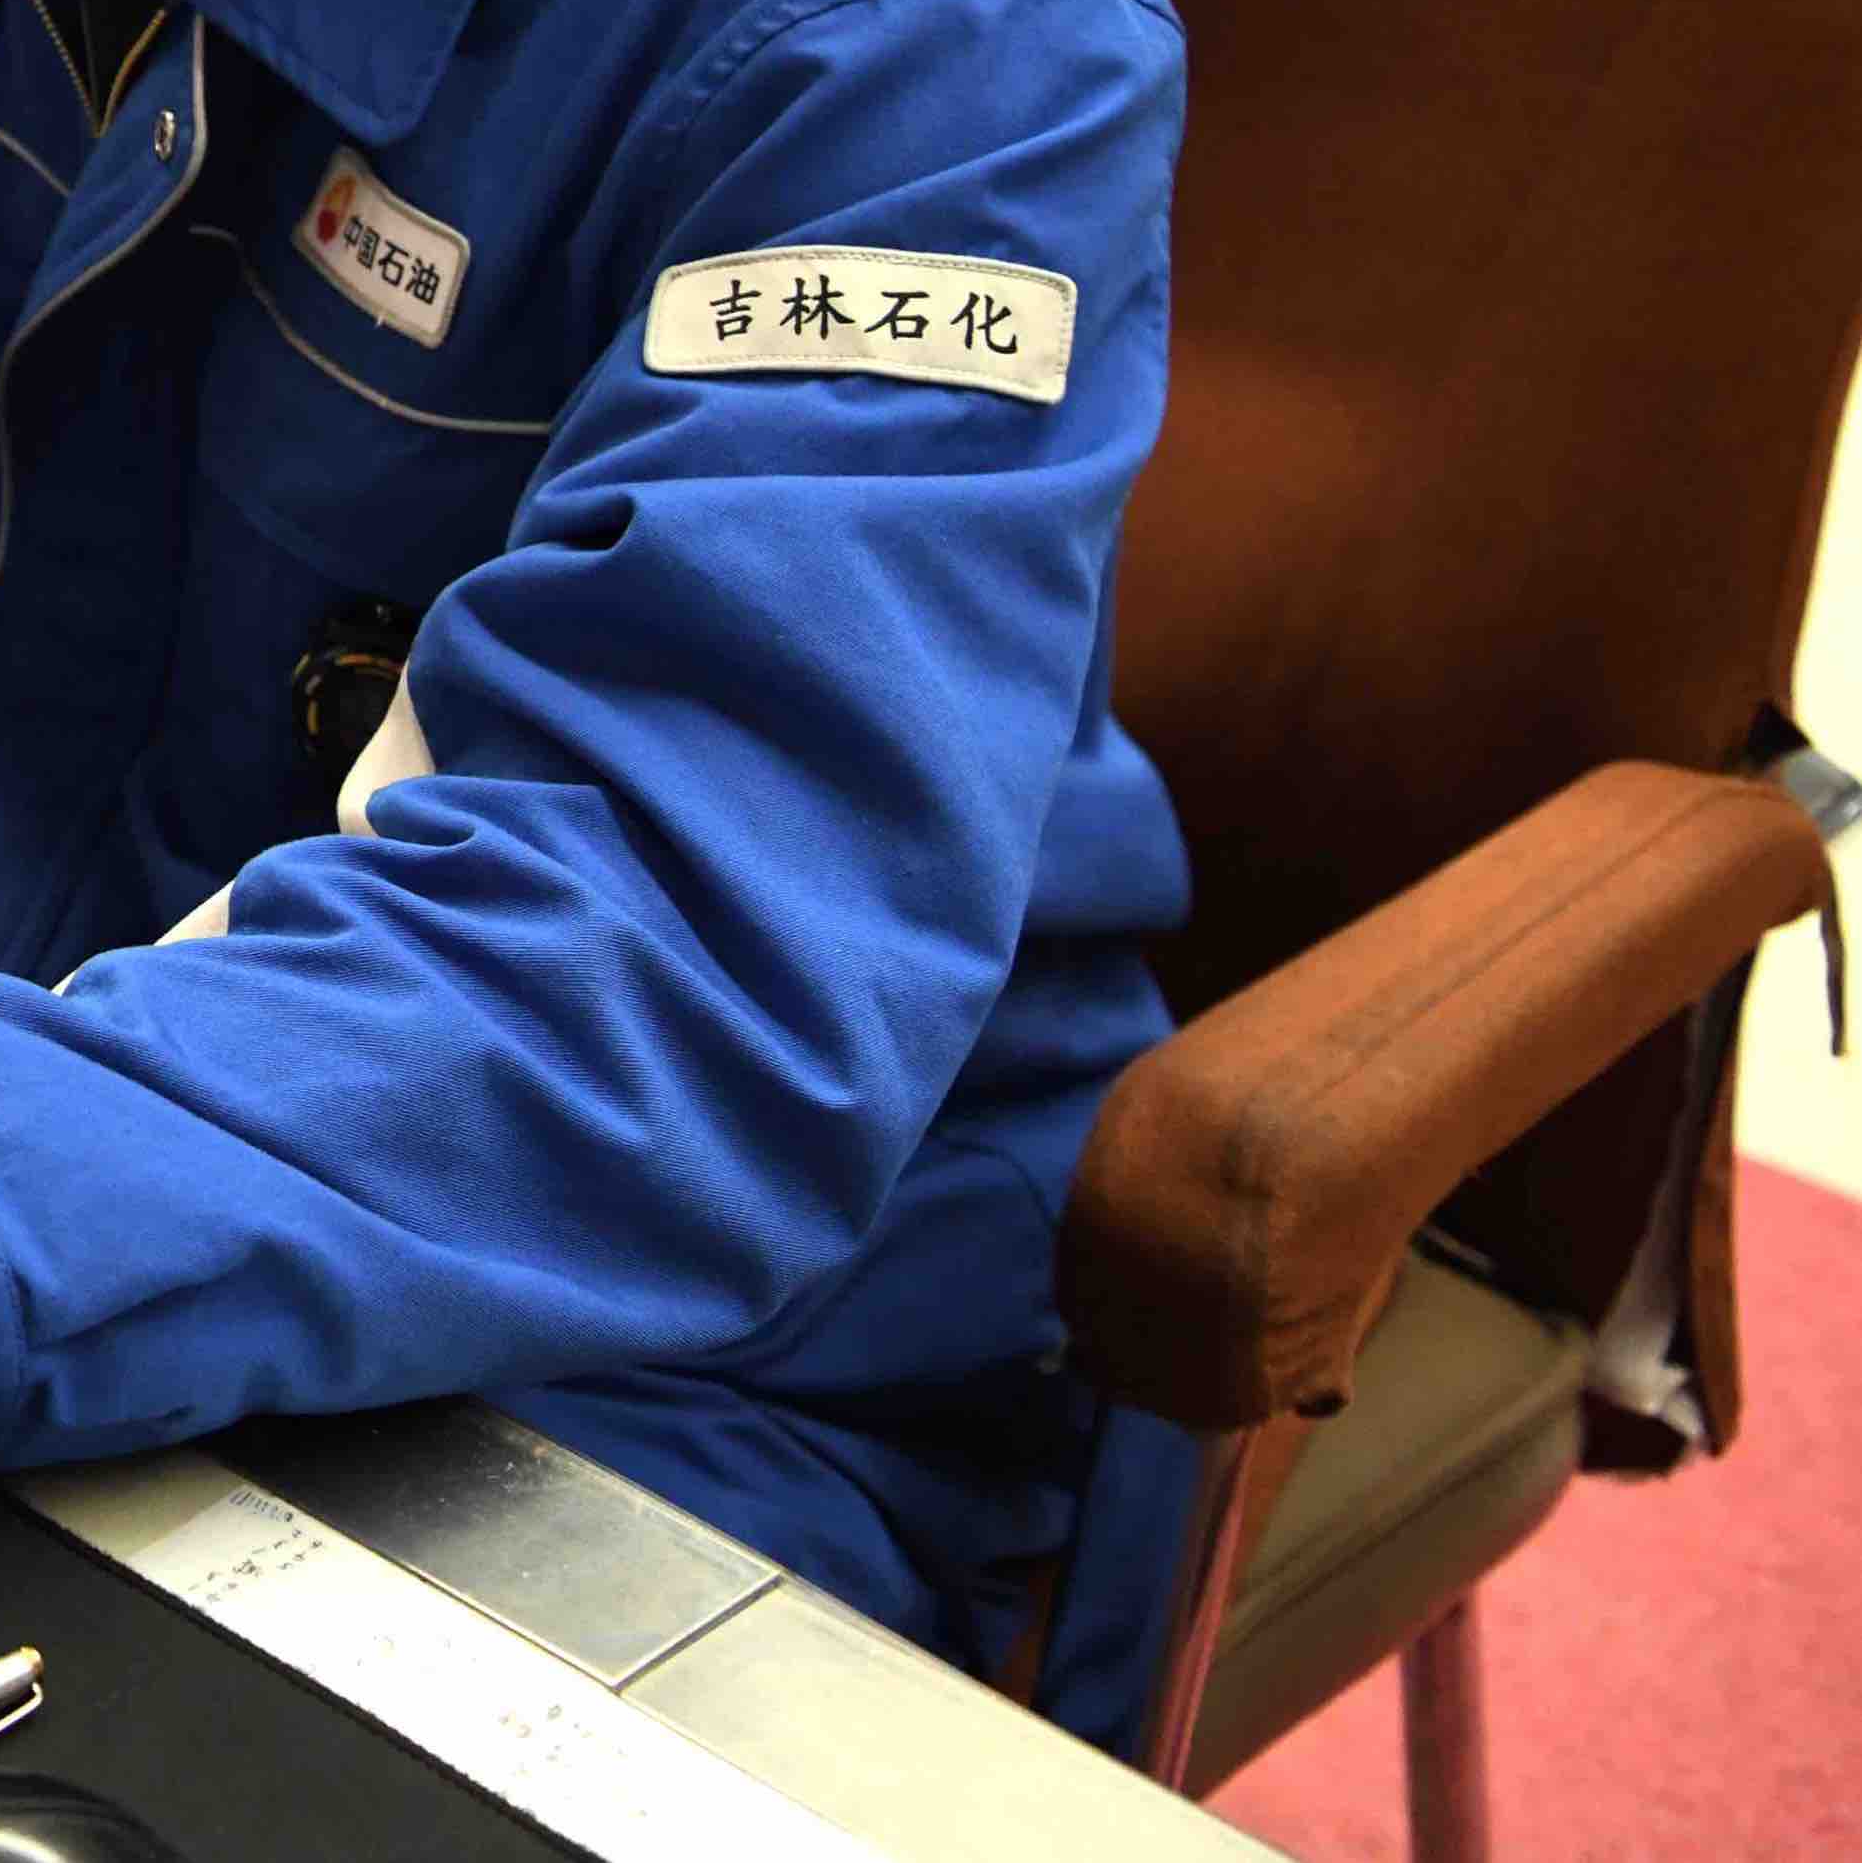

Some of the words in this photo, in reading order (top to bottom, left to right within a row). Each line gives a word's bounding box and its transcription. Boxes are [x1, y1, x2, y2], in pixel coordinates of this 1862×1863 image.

[342, 213, 441, 306] 中国石油
[708, 273, 1019, 355] 吉林石化
